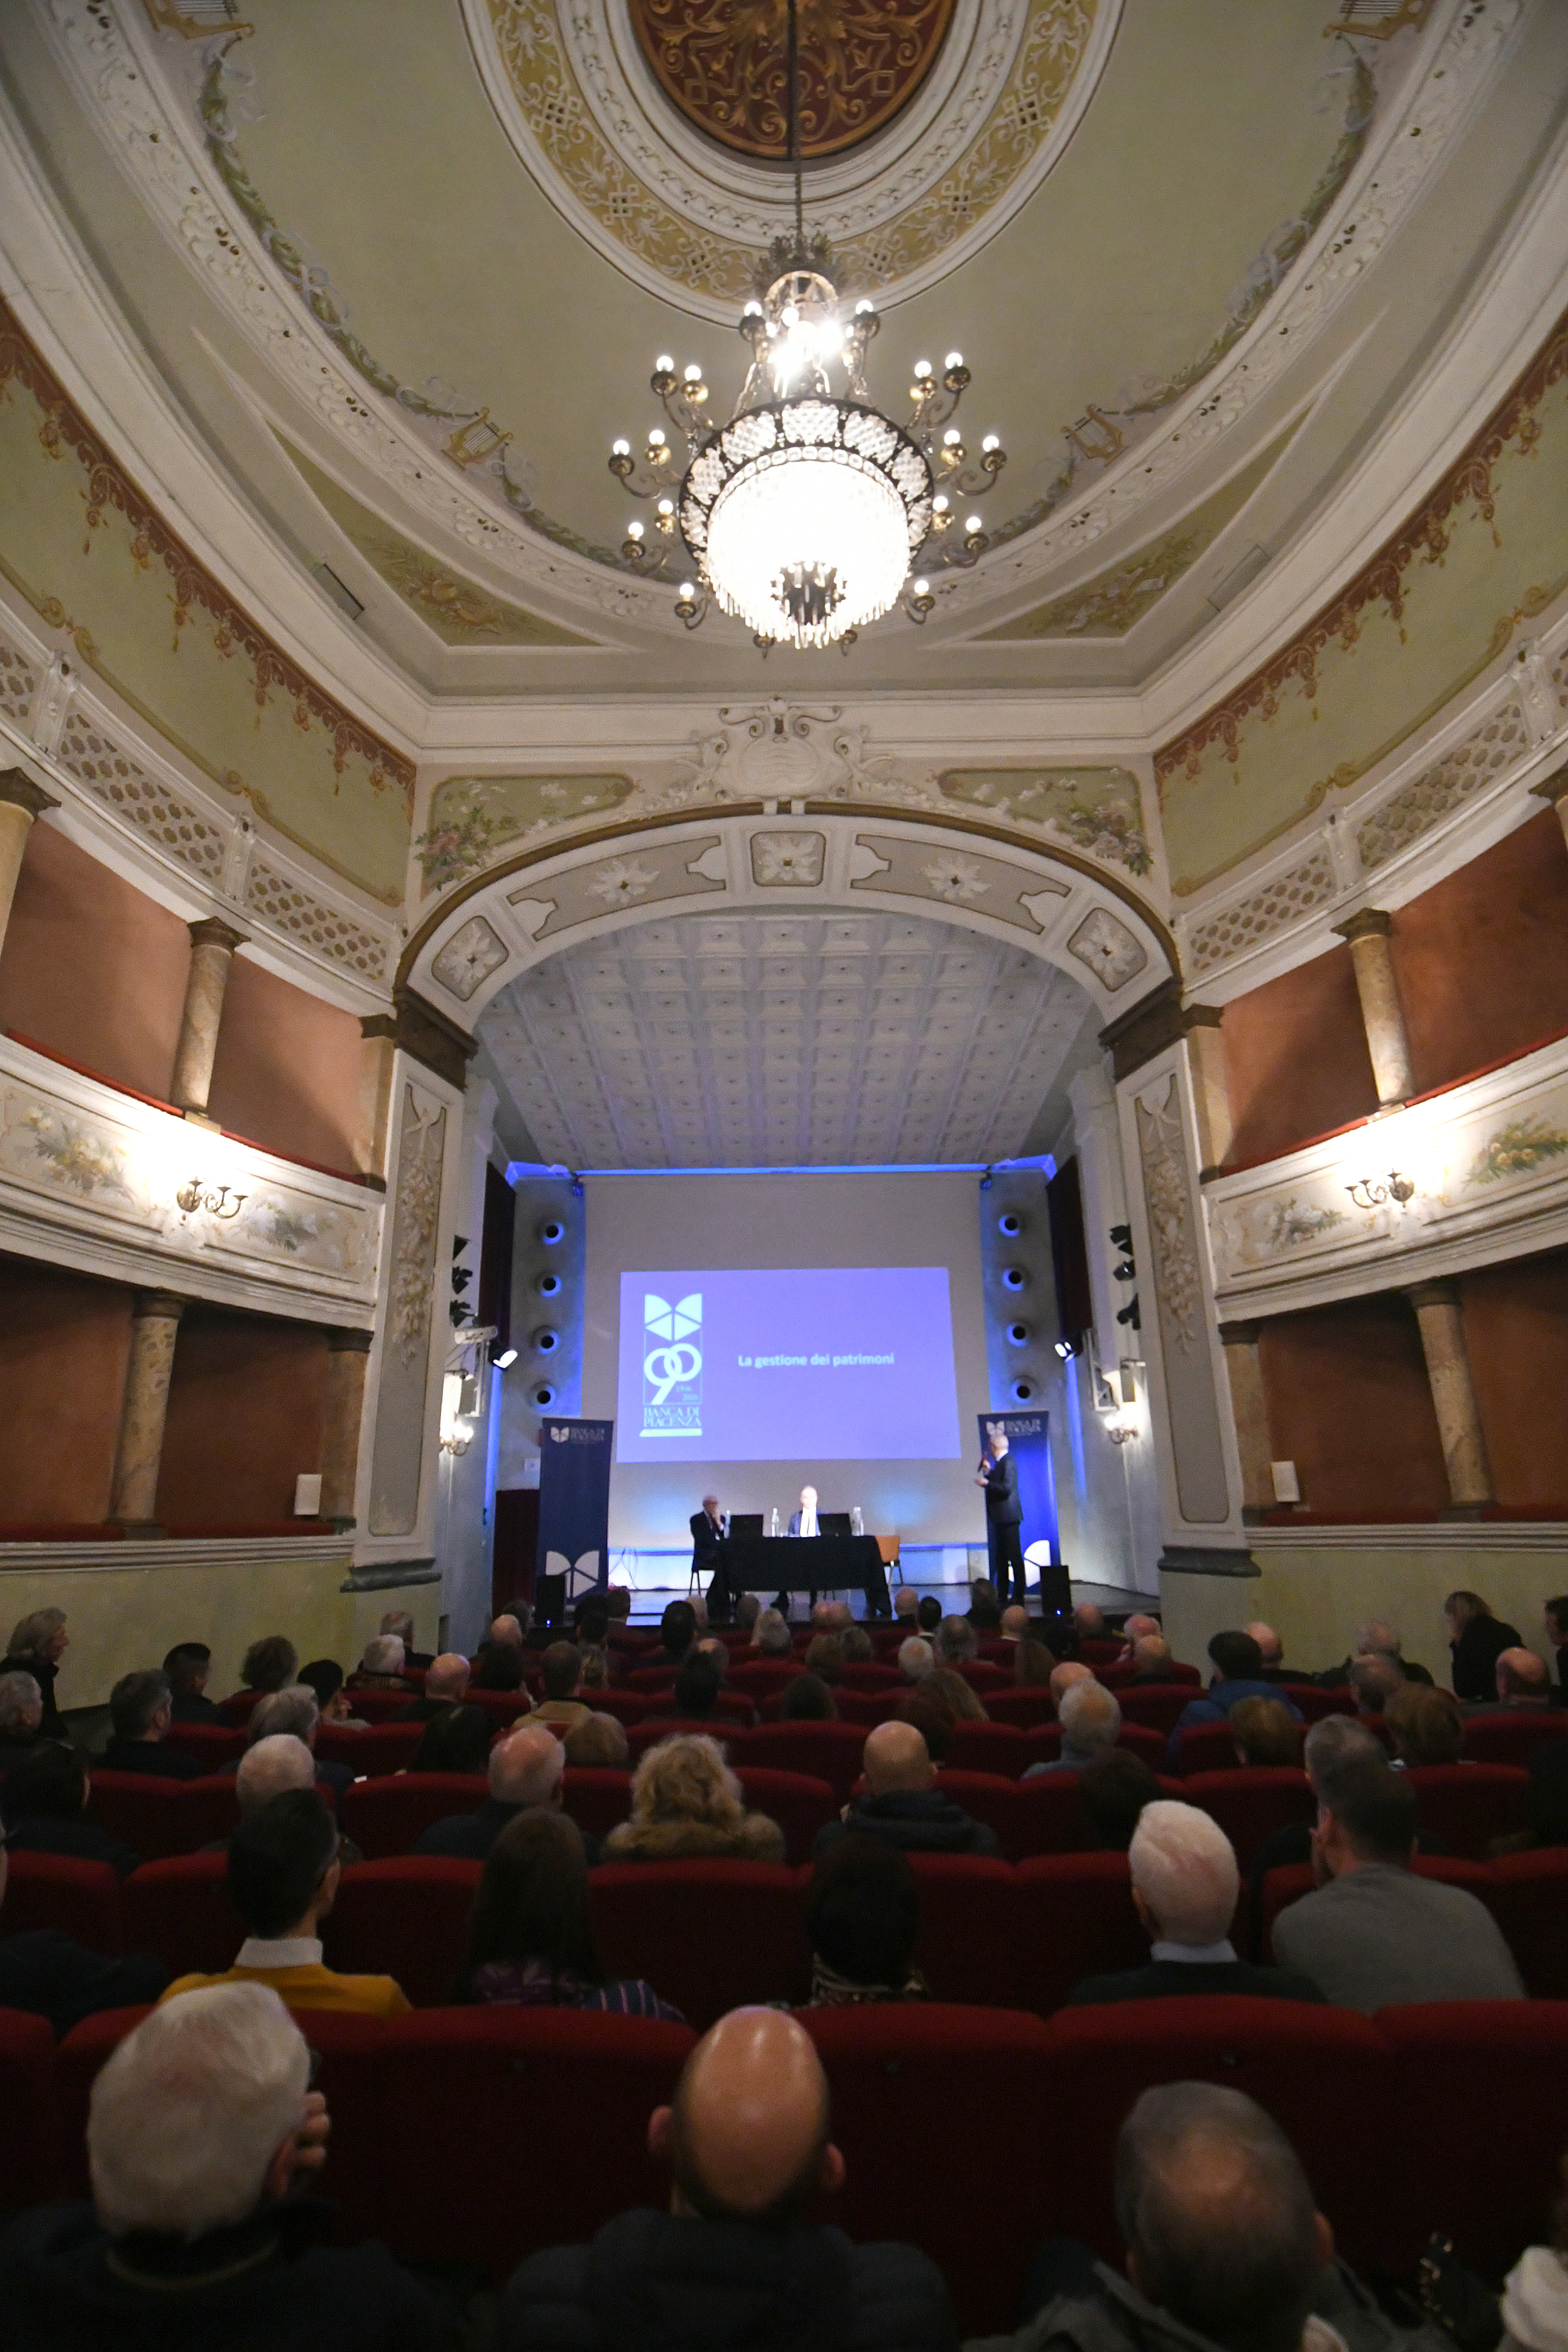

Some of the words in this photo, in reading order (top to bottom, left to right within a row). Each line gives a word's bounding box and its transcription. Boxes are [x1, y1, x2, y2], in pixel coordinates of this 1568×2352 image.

[738, 1355, 752, 1366] La
[755, 1354, 807, 1369] gestione
[810, 1353, 830, 1365] dei
[832, 1352, 894, 1367] patrimoni
[687, 1406, 700, 1416] DI
